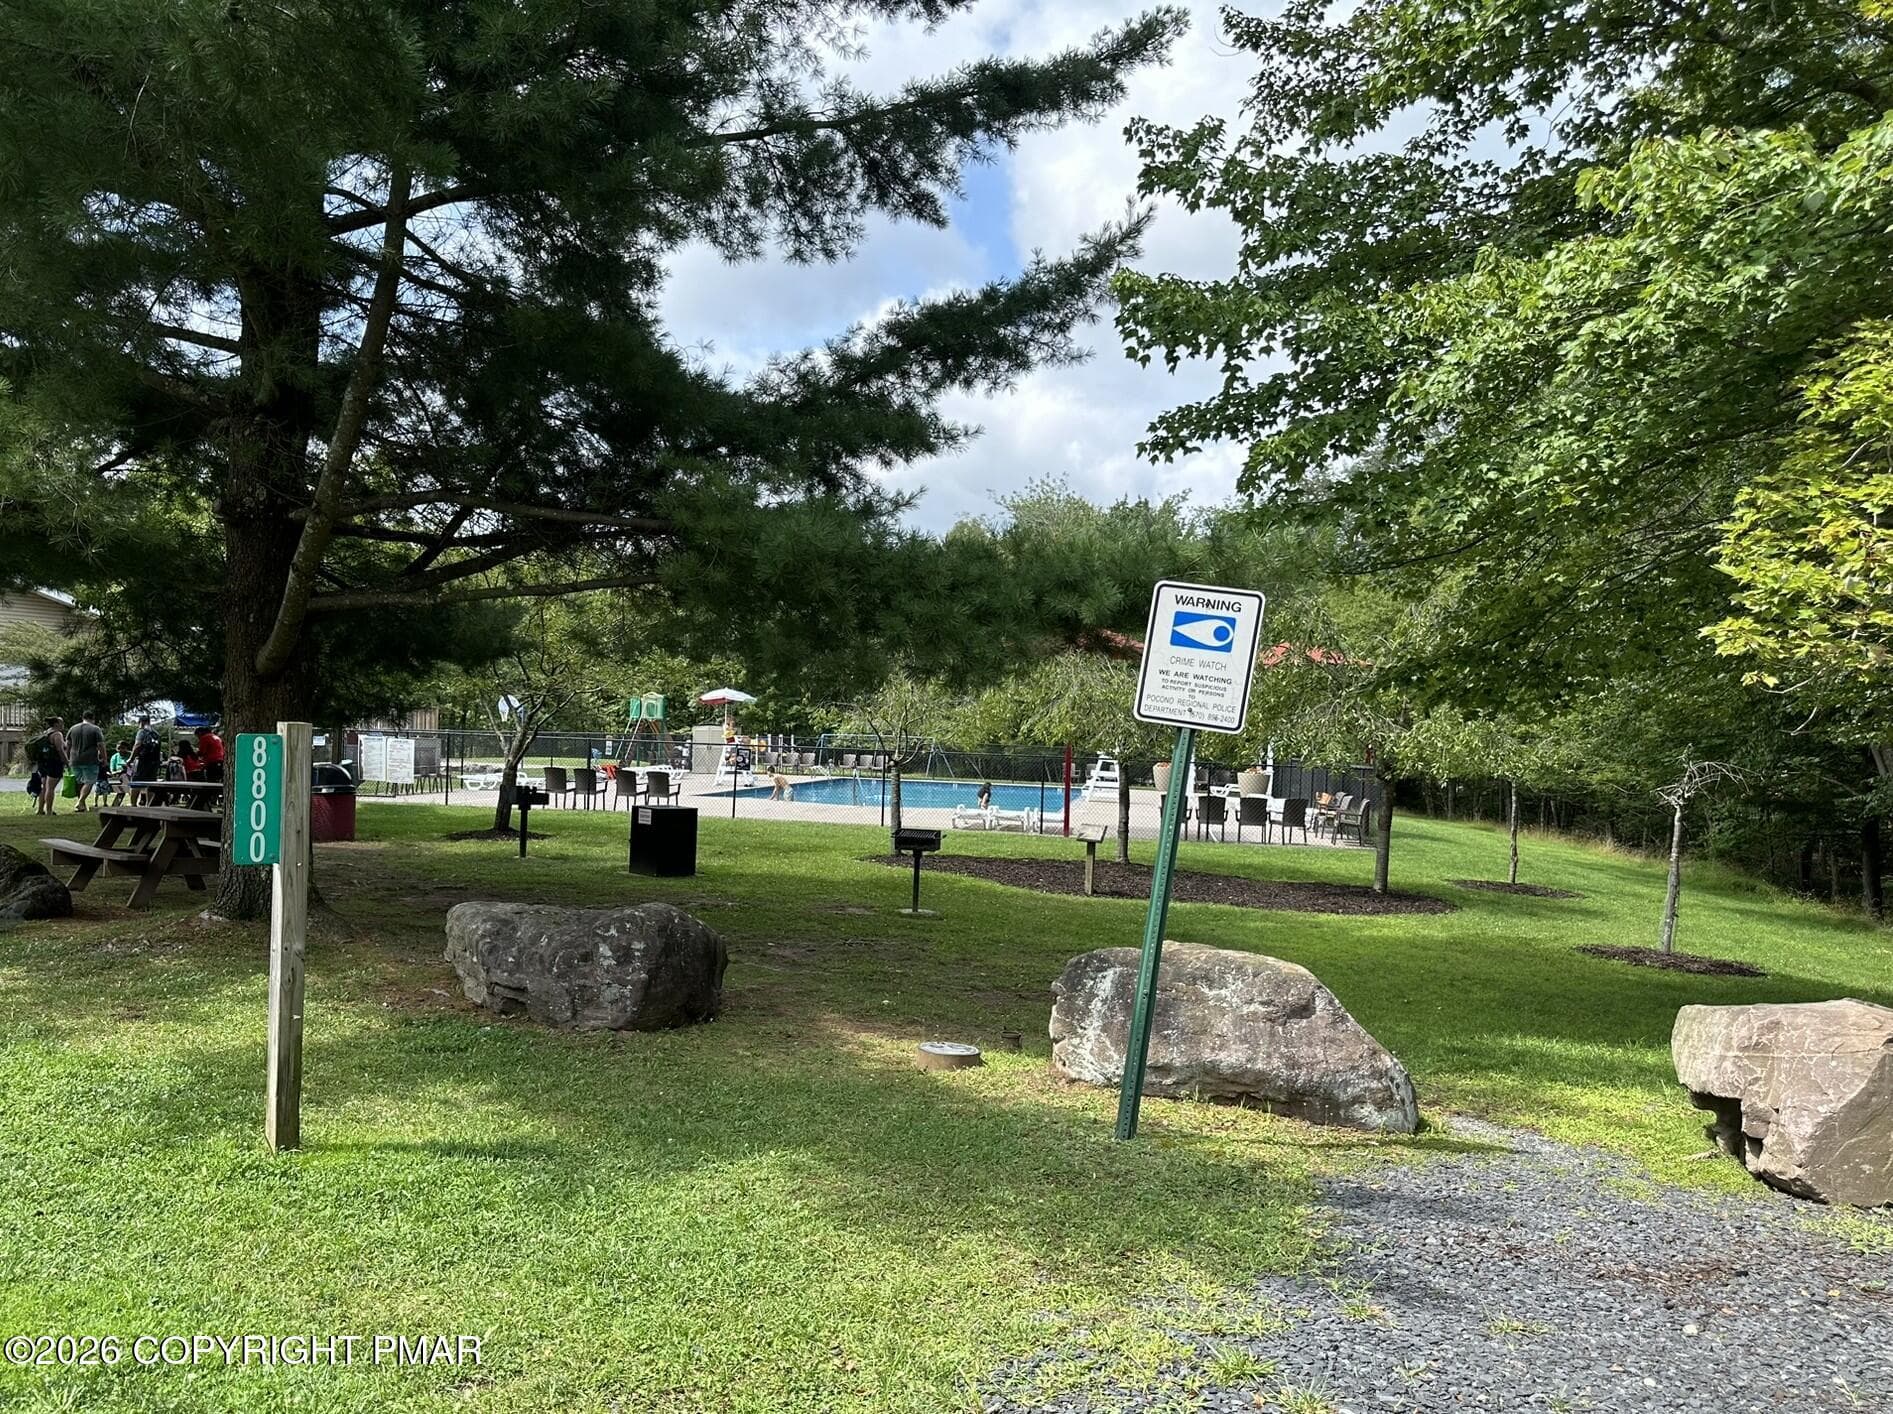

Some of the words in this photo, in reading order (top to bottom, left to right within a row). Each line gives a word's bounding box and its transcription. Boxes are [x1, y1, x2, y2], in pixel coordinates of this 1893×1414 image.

[1175, 594, 1242, 612] WARNING
[1170, 656, 1195, 667] CRIME
[1199, 660, 1227, 671] WATCH
[1193, 674, 1232, 685] WATCHING
[1194, 683, 1227, 692] SUSPICIOUS
[1198, 690, 1225, 698] PERSONS
[1144, 704, 1186, 716] DEPARTMENT
[1147, 694, 1174, 704] POCONO
[1177, 699, 1209, 710] REGIONAL
[1213, 703, 1236, 713] POLICE
[250, 736, 267, 863] 8800
